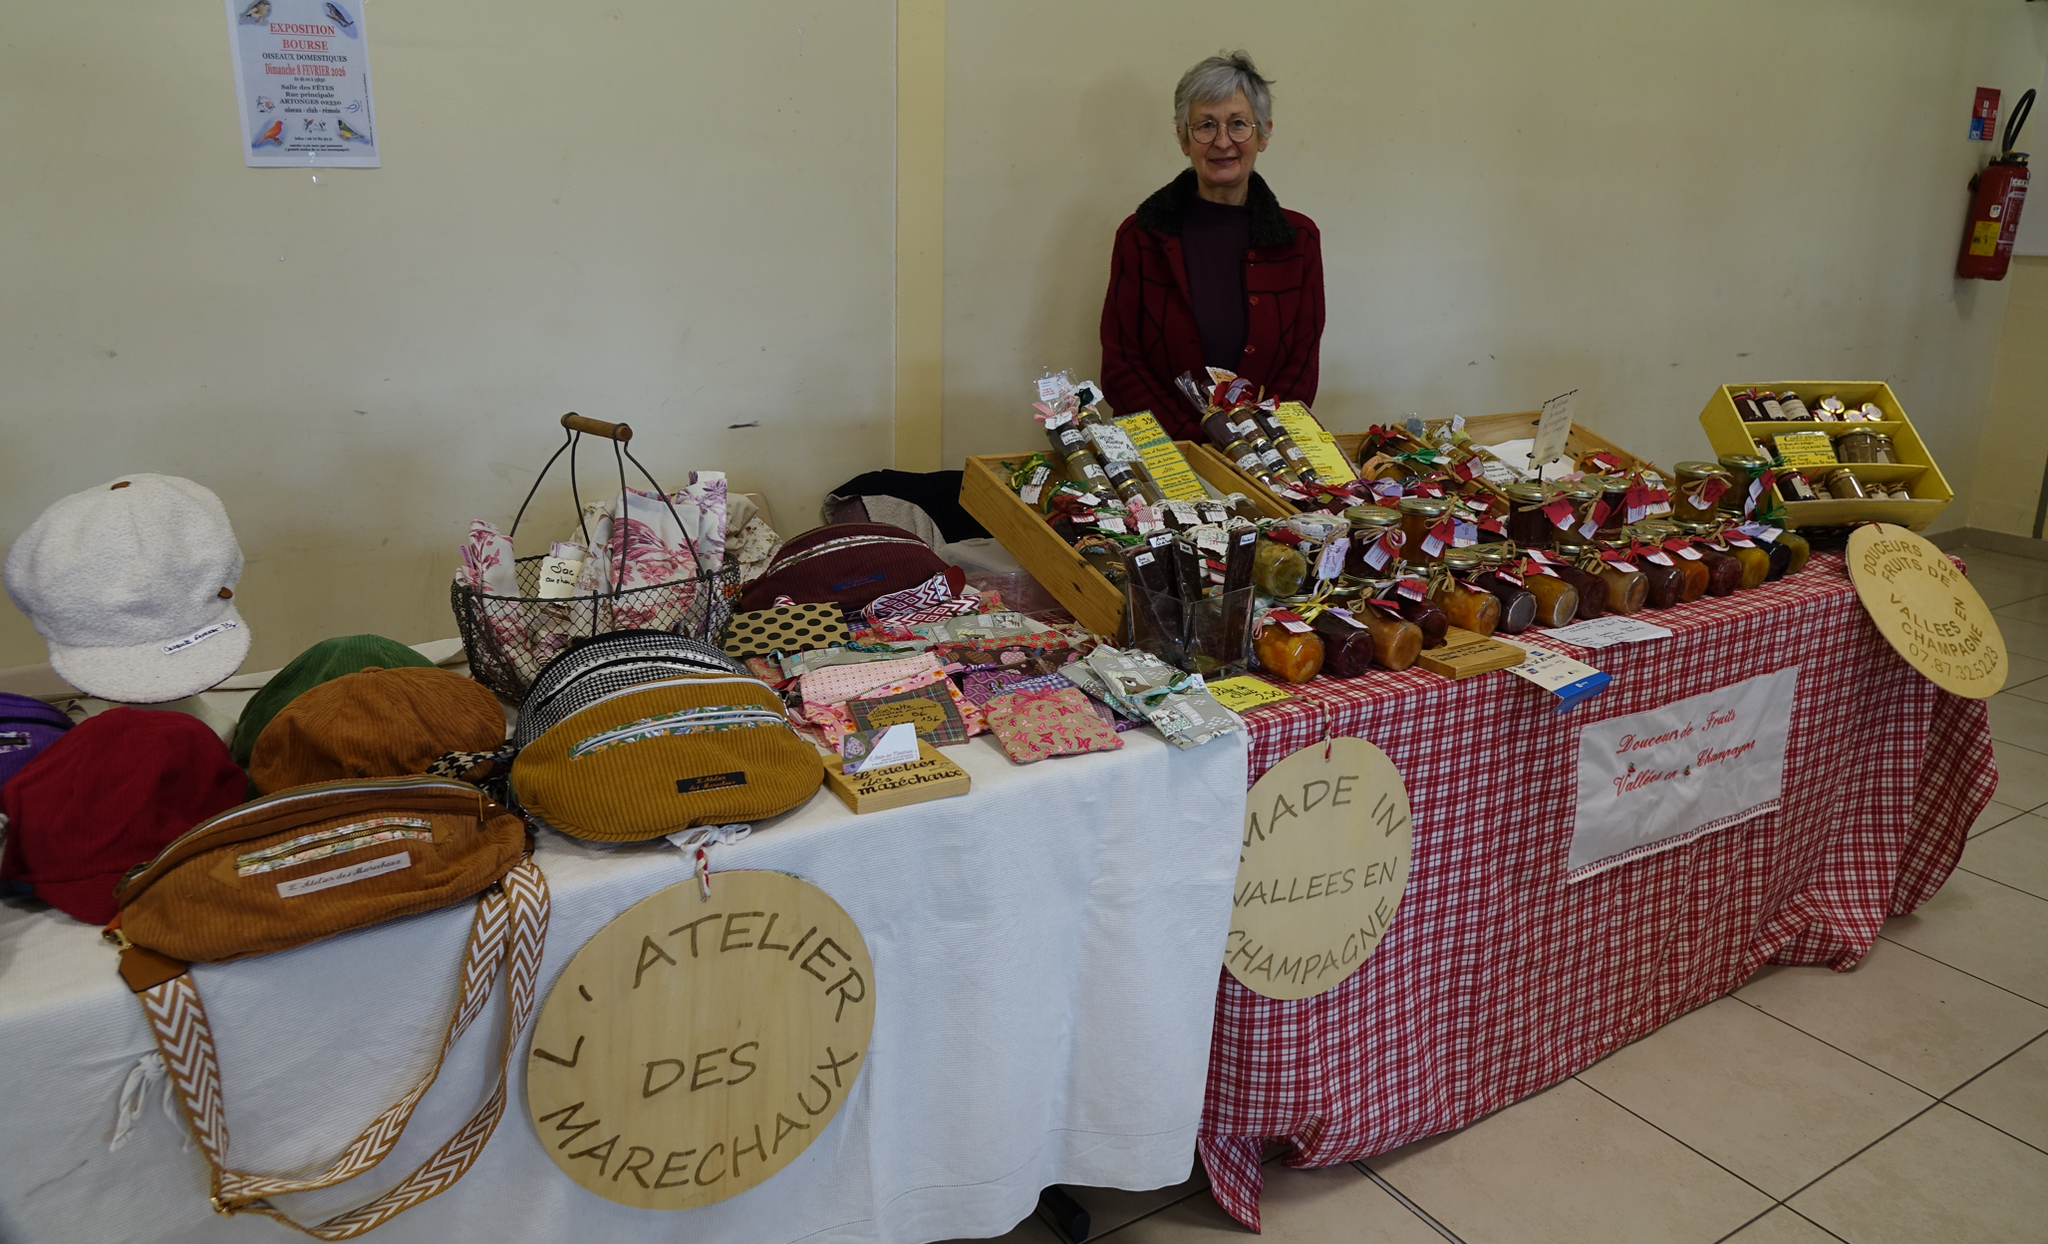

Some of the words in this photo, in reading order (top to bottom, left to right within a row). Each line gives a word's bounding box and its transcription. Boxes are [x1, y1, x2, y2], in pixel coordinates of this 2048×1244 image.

[269, 22, 336, 35] EXPOSITION
[281, 39, 329, 51] BOURSE
[262, 52, 295, 61] OISEAUX
[296, 54, 348, 63] DOMESTIQUES
[264, 63, 296, 75] Dimanche
[296, 65, 302, 75] 8
[302, 65, 331, 77] FEVRIER
[330, 67, 347, 78] 2026
[550, 561, 575, 576] Sac
[1864, 540, 1922, 577] DOUCEURS
[1938, 558, 1959, 582] DE
[1882, 557, 1922, 584] FRUITS
[1928, 565, 1950, 588] DE
[1890, 593, 1961, 637] VALLEES
[1953, 596, 1967, 622] EN
[1901, 623, 1983, 657] CHAMPAGNE
[1616, 729, 1679, 755] Douceurs
[1679, 721, 1695, 738] de
[1701, 708, 1737, 732] Fruits
[858, 769, 962, 796] maréchaux
[862, 777, 893, 787] des
[1613, 770, 1663, 797] Vallées
[1663, 769, 1679, 781] en
[1696, 739, 1757, 768] Champagne
[1241, 775, 1360, 863] MADE
[1371, 792, 1407, 838] IN
[1233, 867, 1356, 908] VALLEES
[1363, 856, 1398, 889] EN
[1224, 896, 1394, 985] CHAMPAGNE
[642, 1041, 760, 1099] DES
[539, 1046, 859, 1190] MARECHAUX
